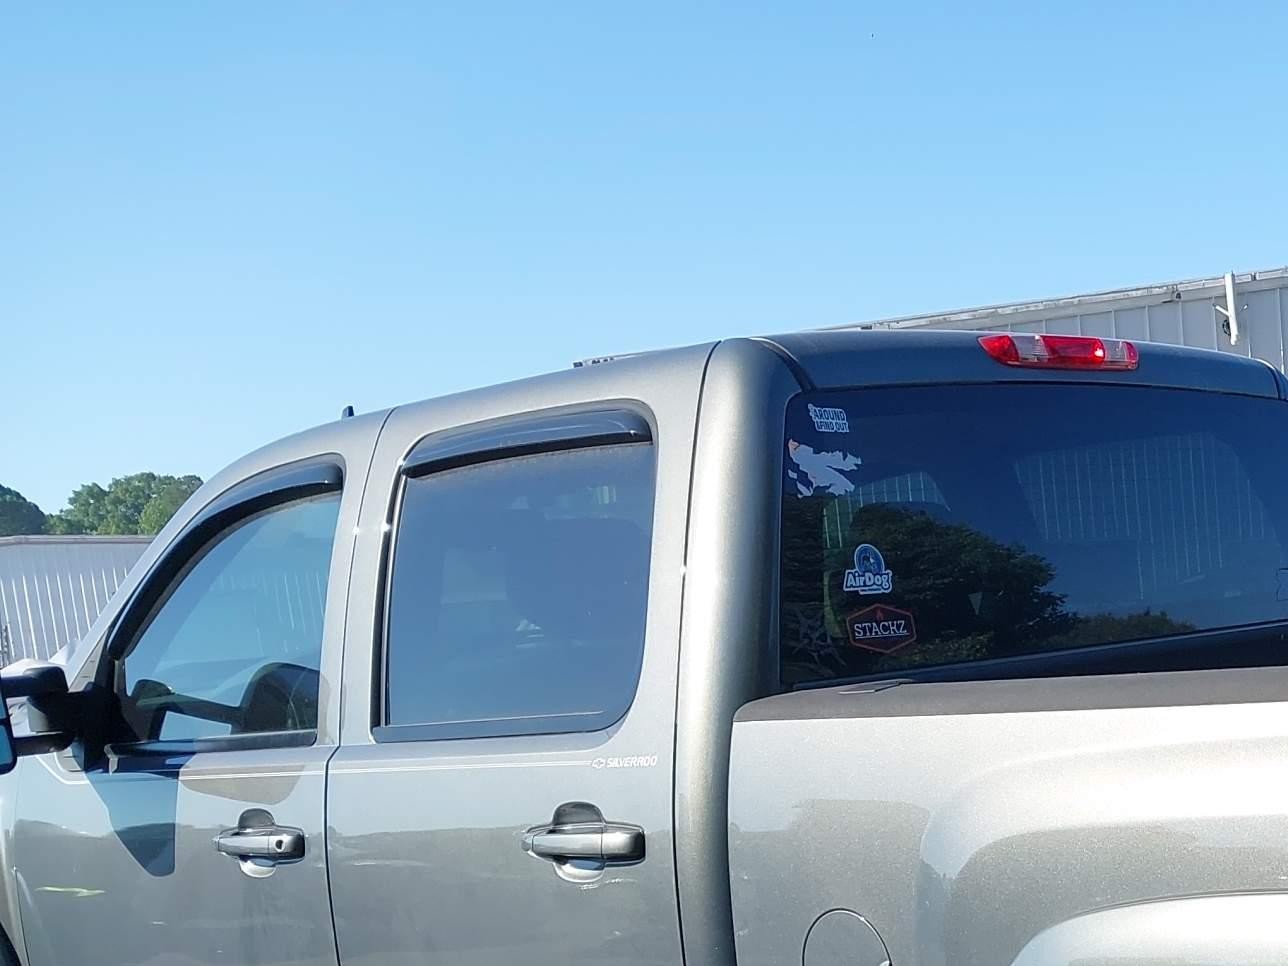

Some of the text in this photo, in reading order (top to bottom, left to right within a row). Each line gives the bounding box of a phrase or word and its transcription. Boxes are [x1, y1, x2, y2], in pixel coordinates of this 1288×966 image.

[813, 408, 846, 421] AROUND
[835, 422, 848, 431] OUT
[846, 571, 891, 590] AirDog
[854, 620, 908, 637] STACKZ
[606, 755, 658, 768] SILVERADO
